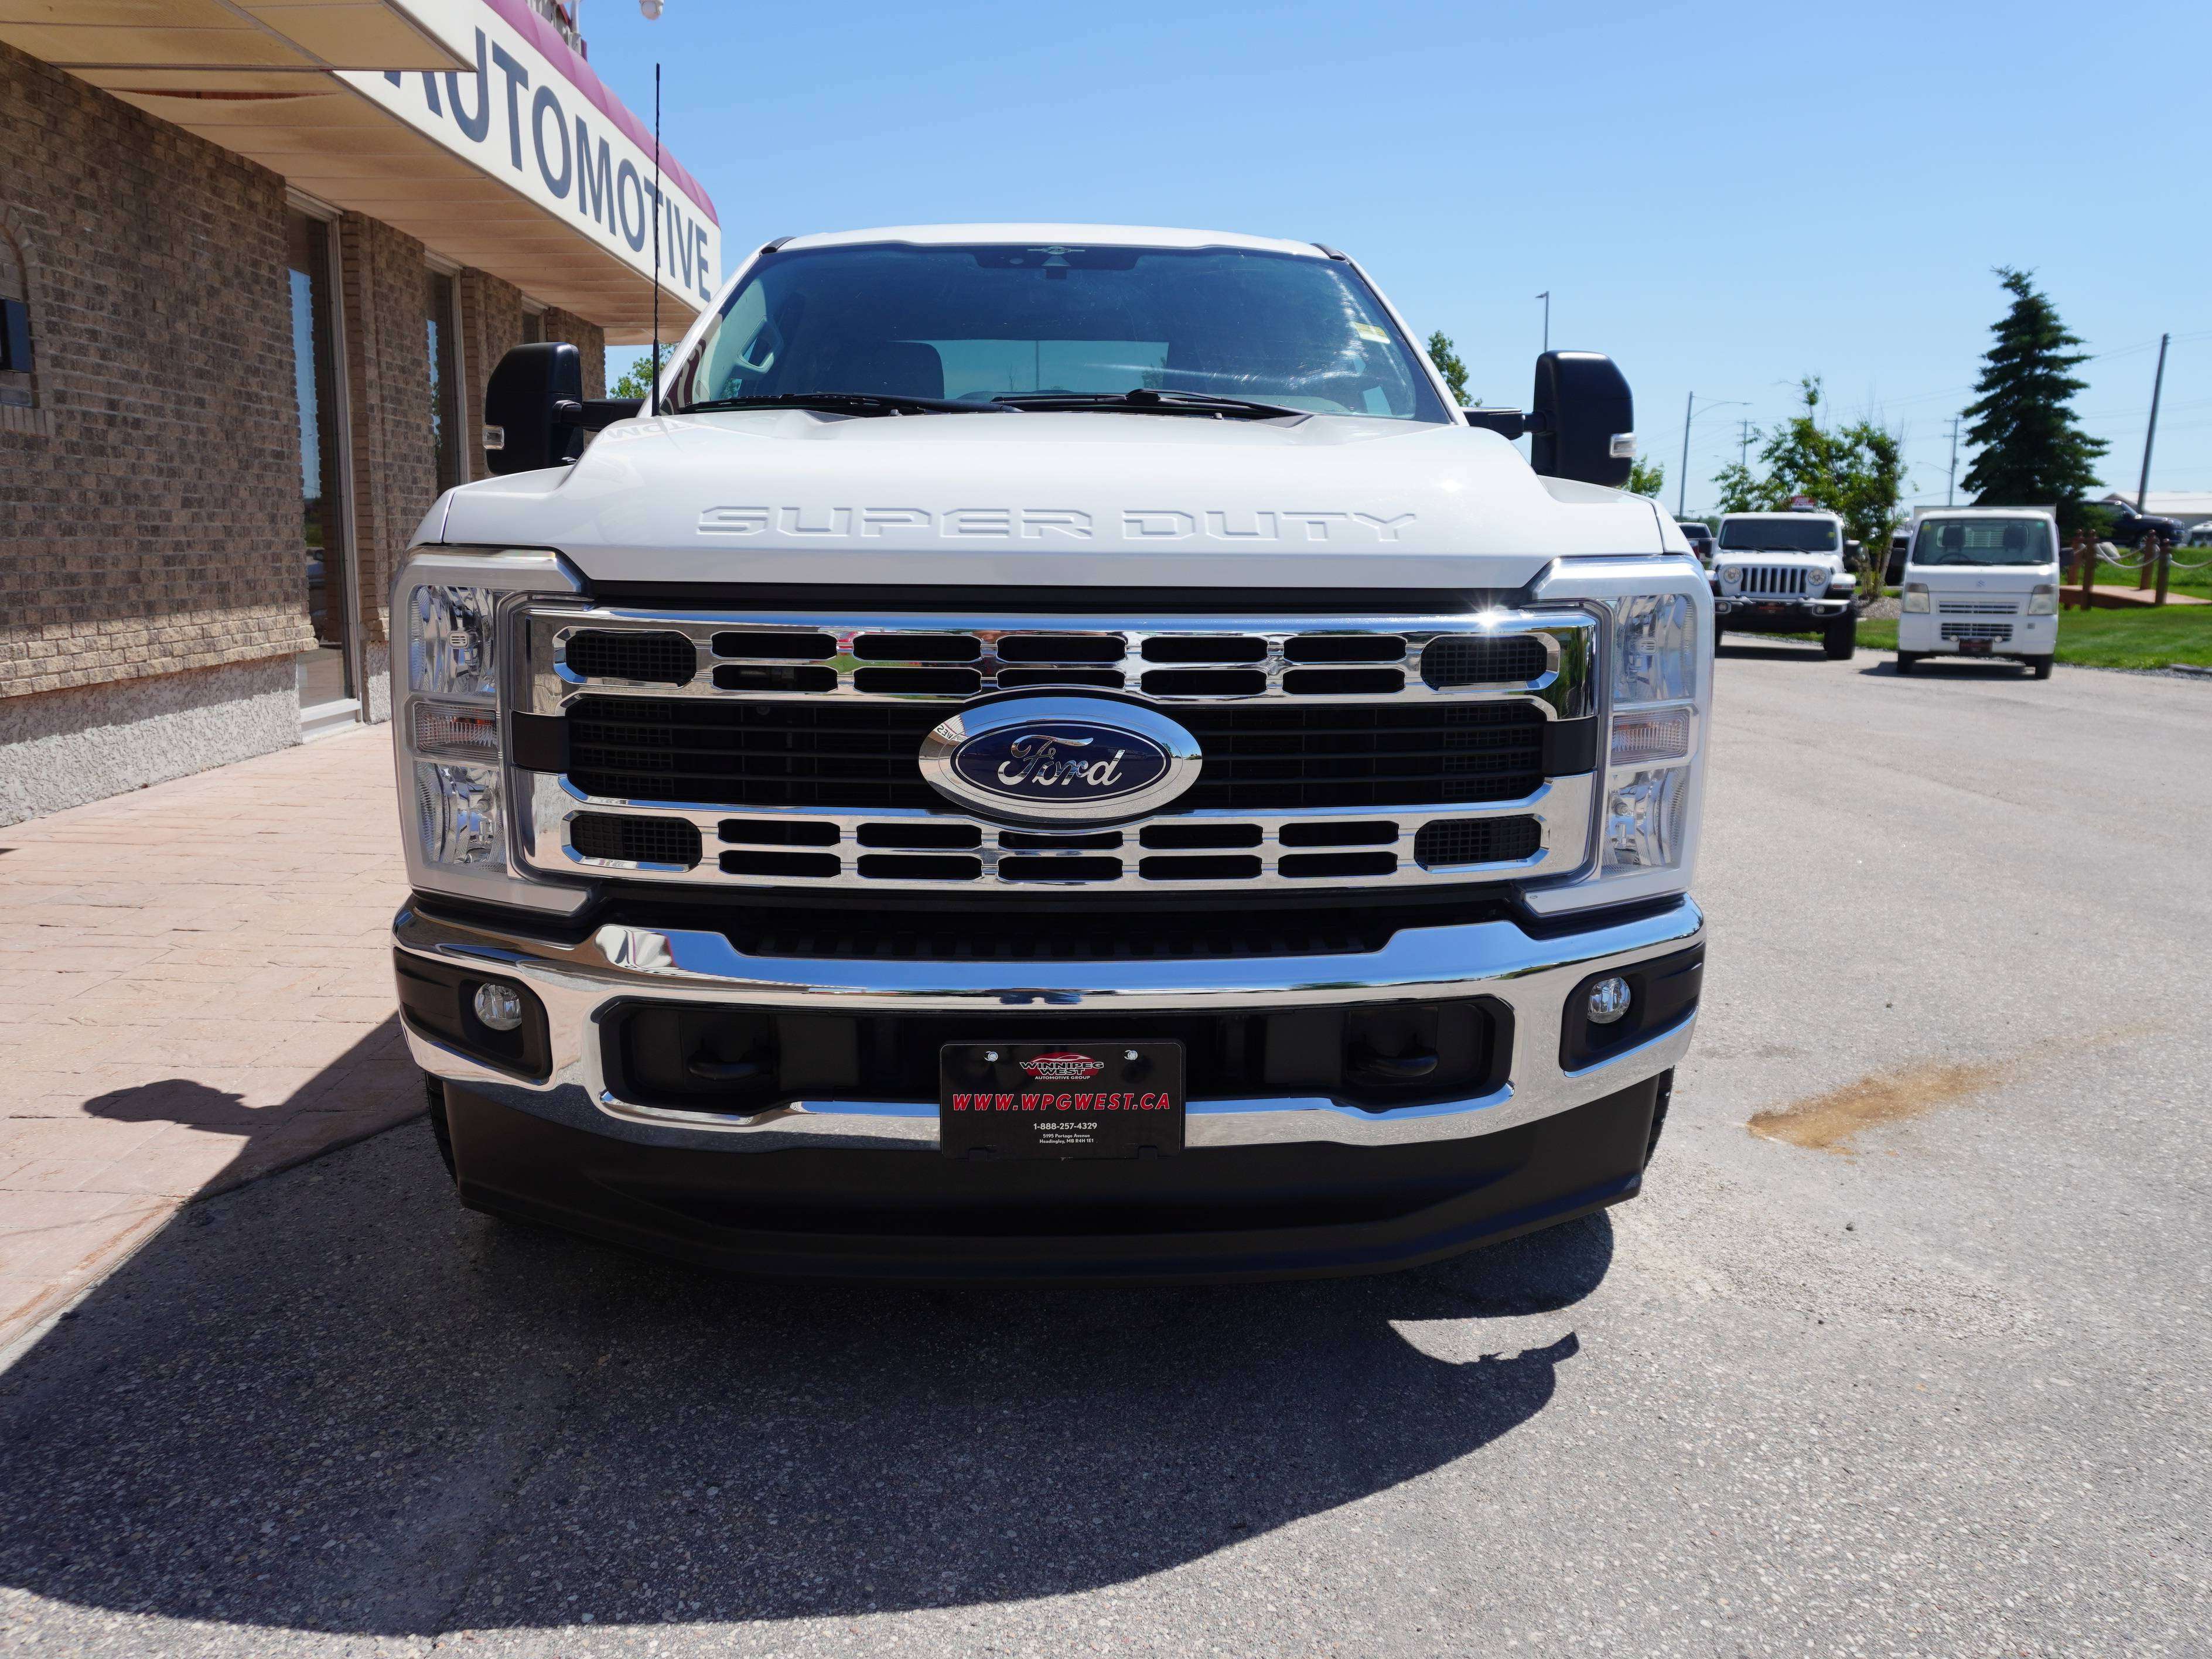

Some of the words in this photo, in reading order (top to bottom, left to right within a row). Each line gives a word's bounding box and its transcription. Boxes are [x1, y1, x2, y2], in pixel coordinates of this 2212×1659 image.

[384, 25, 711, 301] UTOMOTIVE
[696, 506, 1094, 540] SUPER
[1121, 509, 1418, 542] DUTY
[998, 734, 1122, 786] Ford
[953, 1093, 1170, 1111] WWW.WPGWEST.CA
